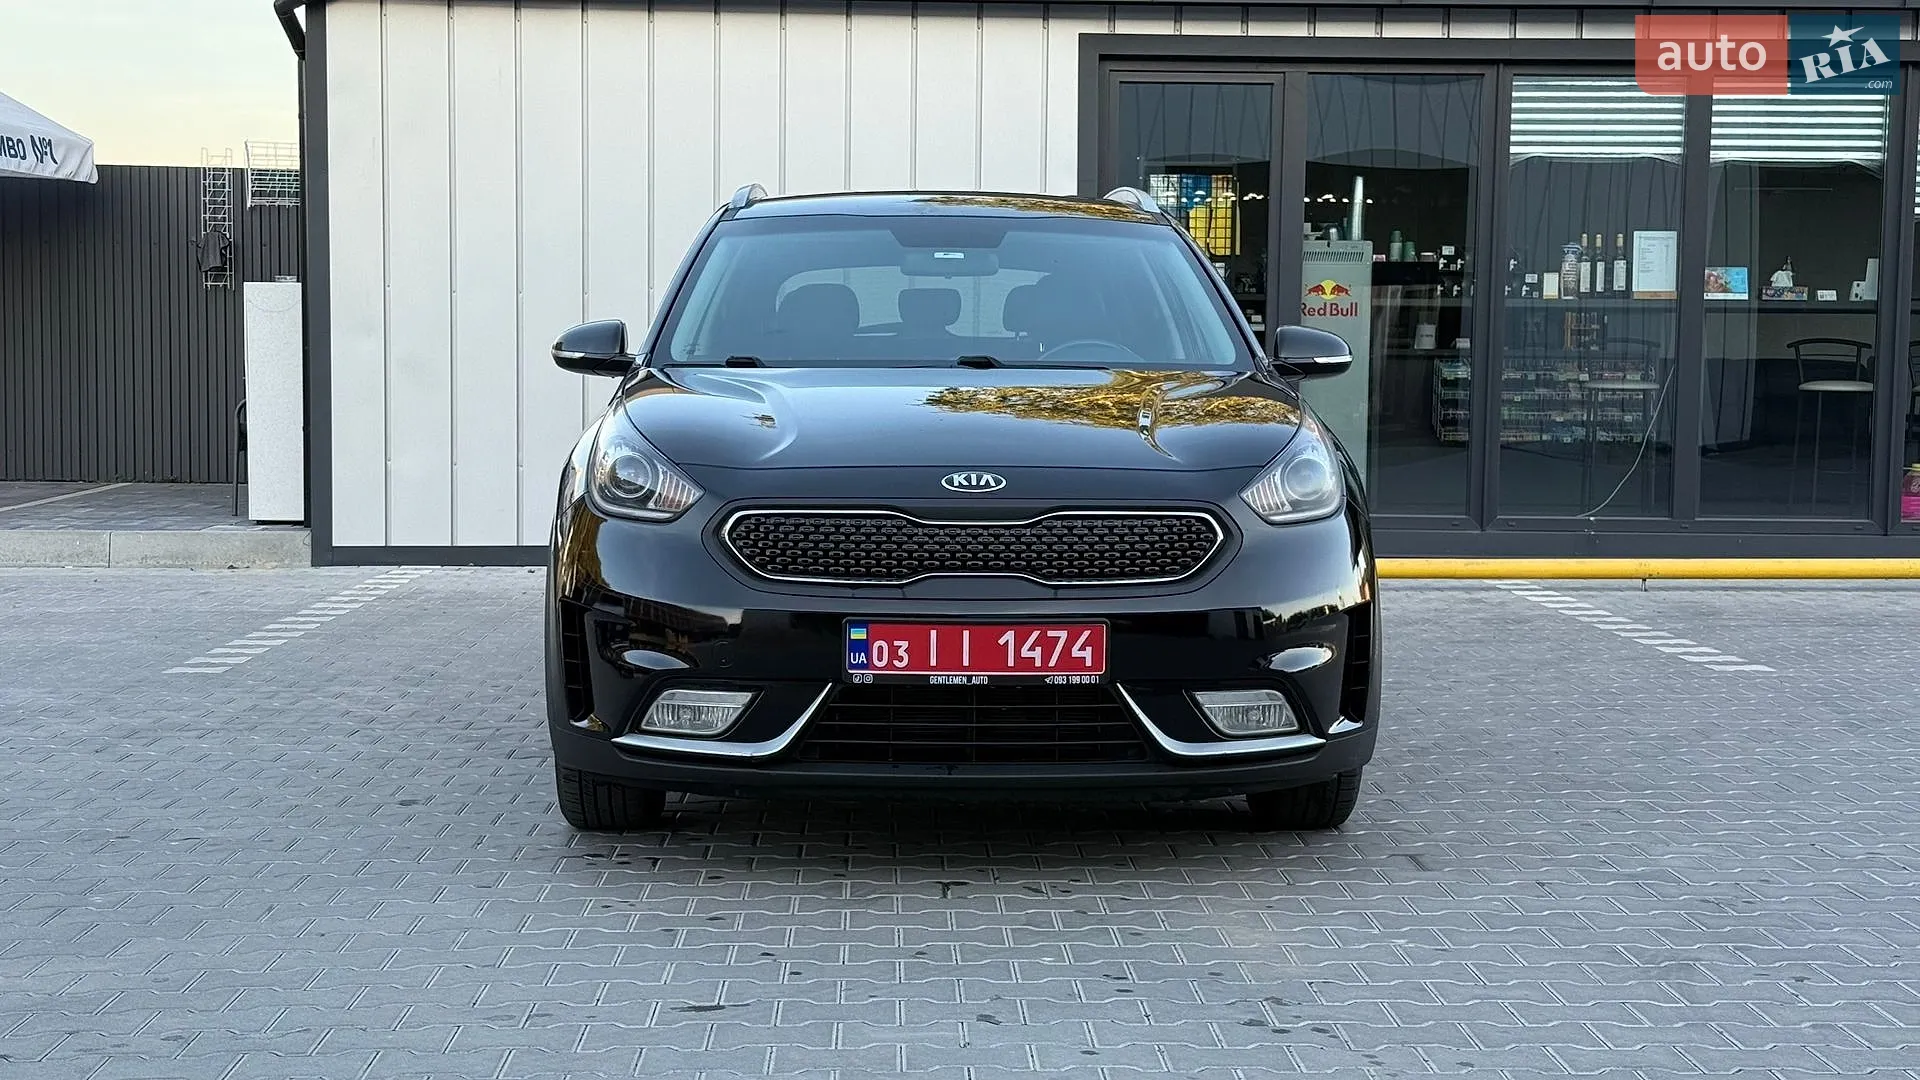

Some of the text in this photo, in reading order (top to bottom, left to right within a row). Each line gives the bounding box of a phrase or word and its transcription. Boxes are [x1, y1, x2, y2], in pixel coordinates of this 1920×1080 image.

[1301, 302, 1358, 317] Red Bull
[952, 473, 997, 487] KIA
[872, 640, 909, 668] 03
[997, 630, 1093, 667] 1474
[850, 652, 868, 664] UA
[1054, 675, 1067, 685] 093
